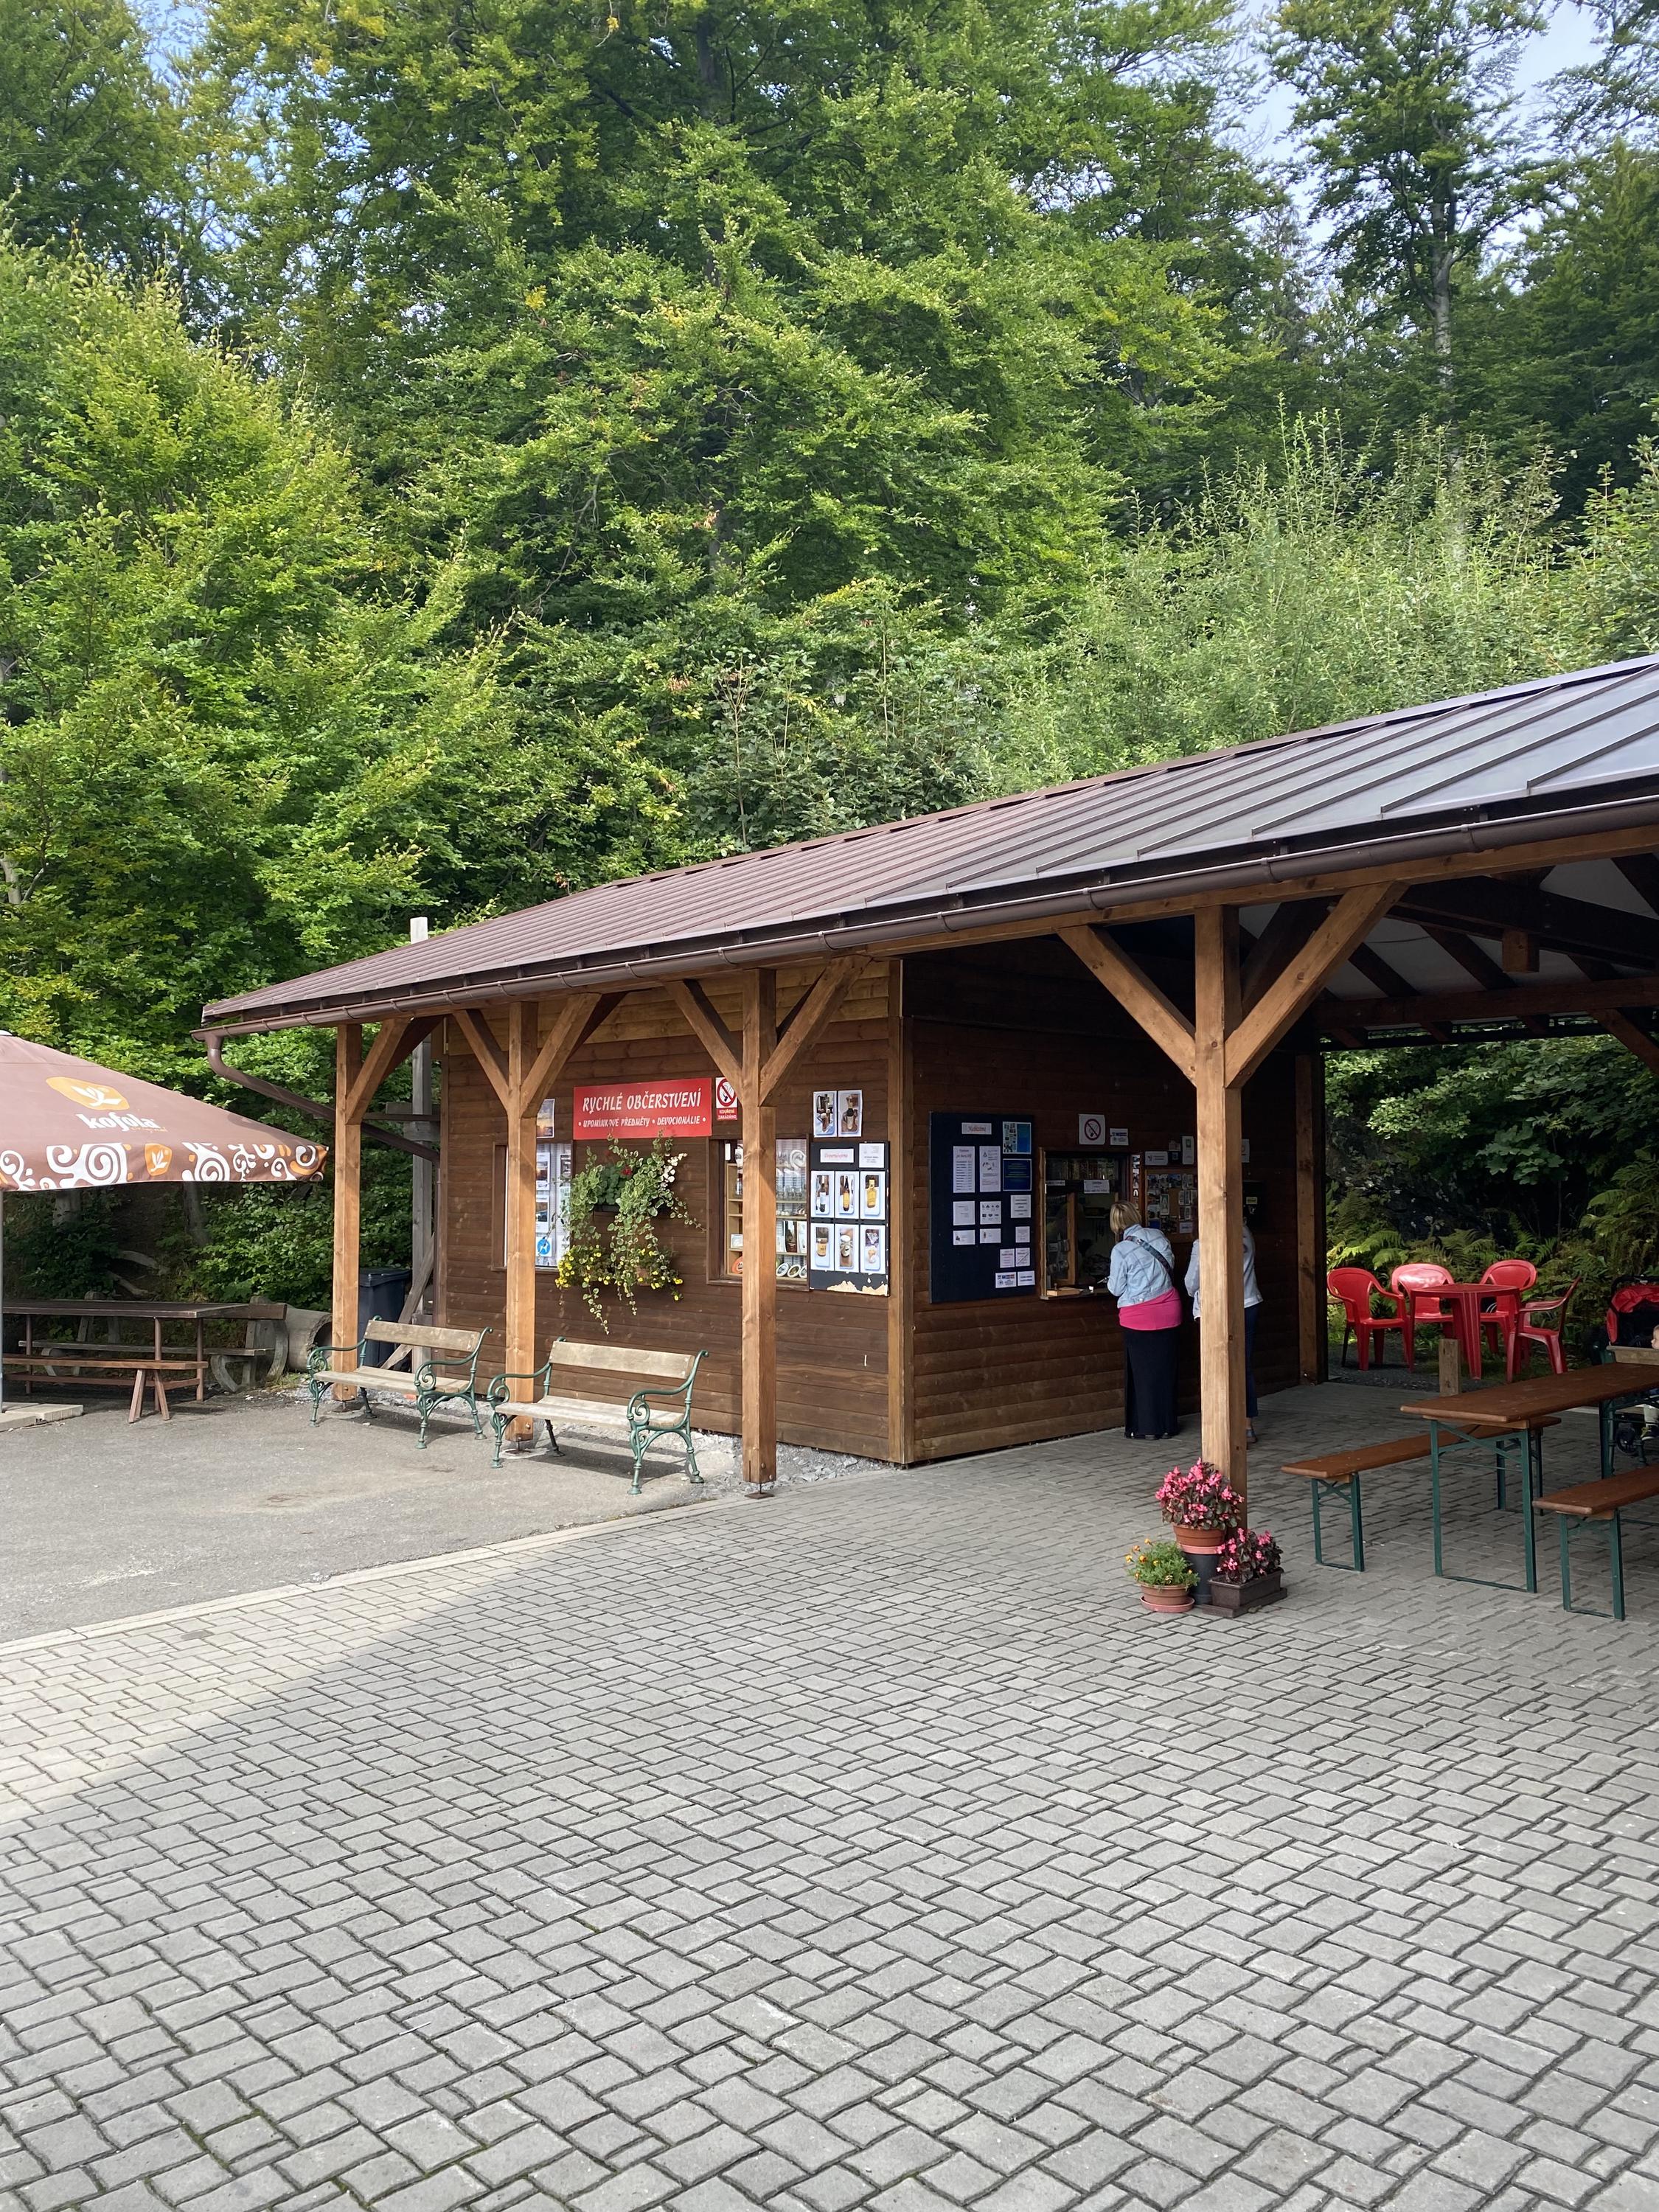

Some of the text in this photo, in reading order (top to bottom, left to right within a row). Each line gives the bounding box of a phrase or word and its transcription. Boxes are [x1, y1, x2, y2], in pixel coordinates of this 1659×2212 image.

[582, 1088, 701, 1114] RYCHLÉ OBČERSTVENÍ
[75, 1112, 161, 1132] kofola
[620, 1116, 650, 1127] PŘEDMĚTY
[656, 1114, 700, 1126] DEVOCIONÁLIE
